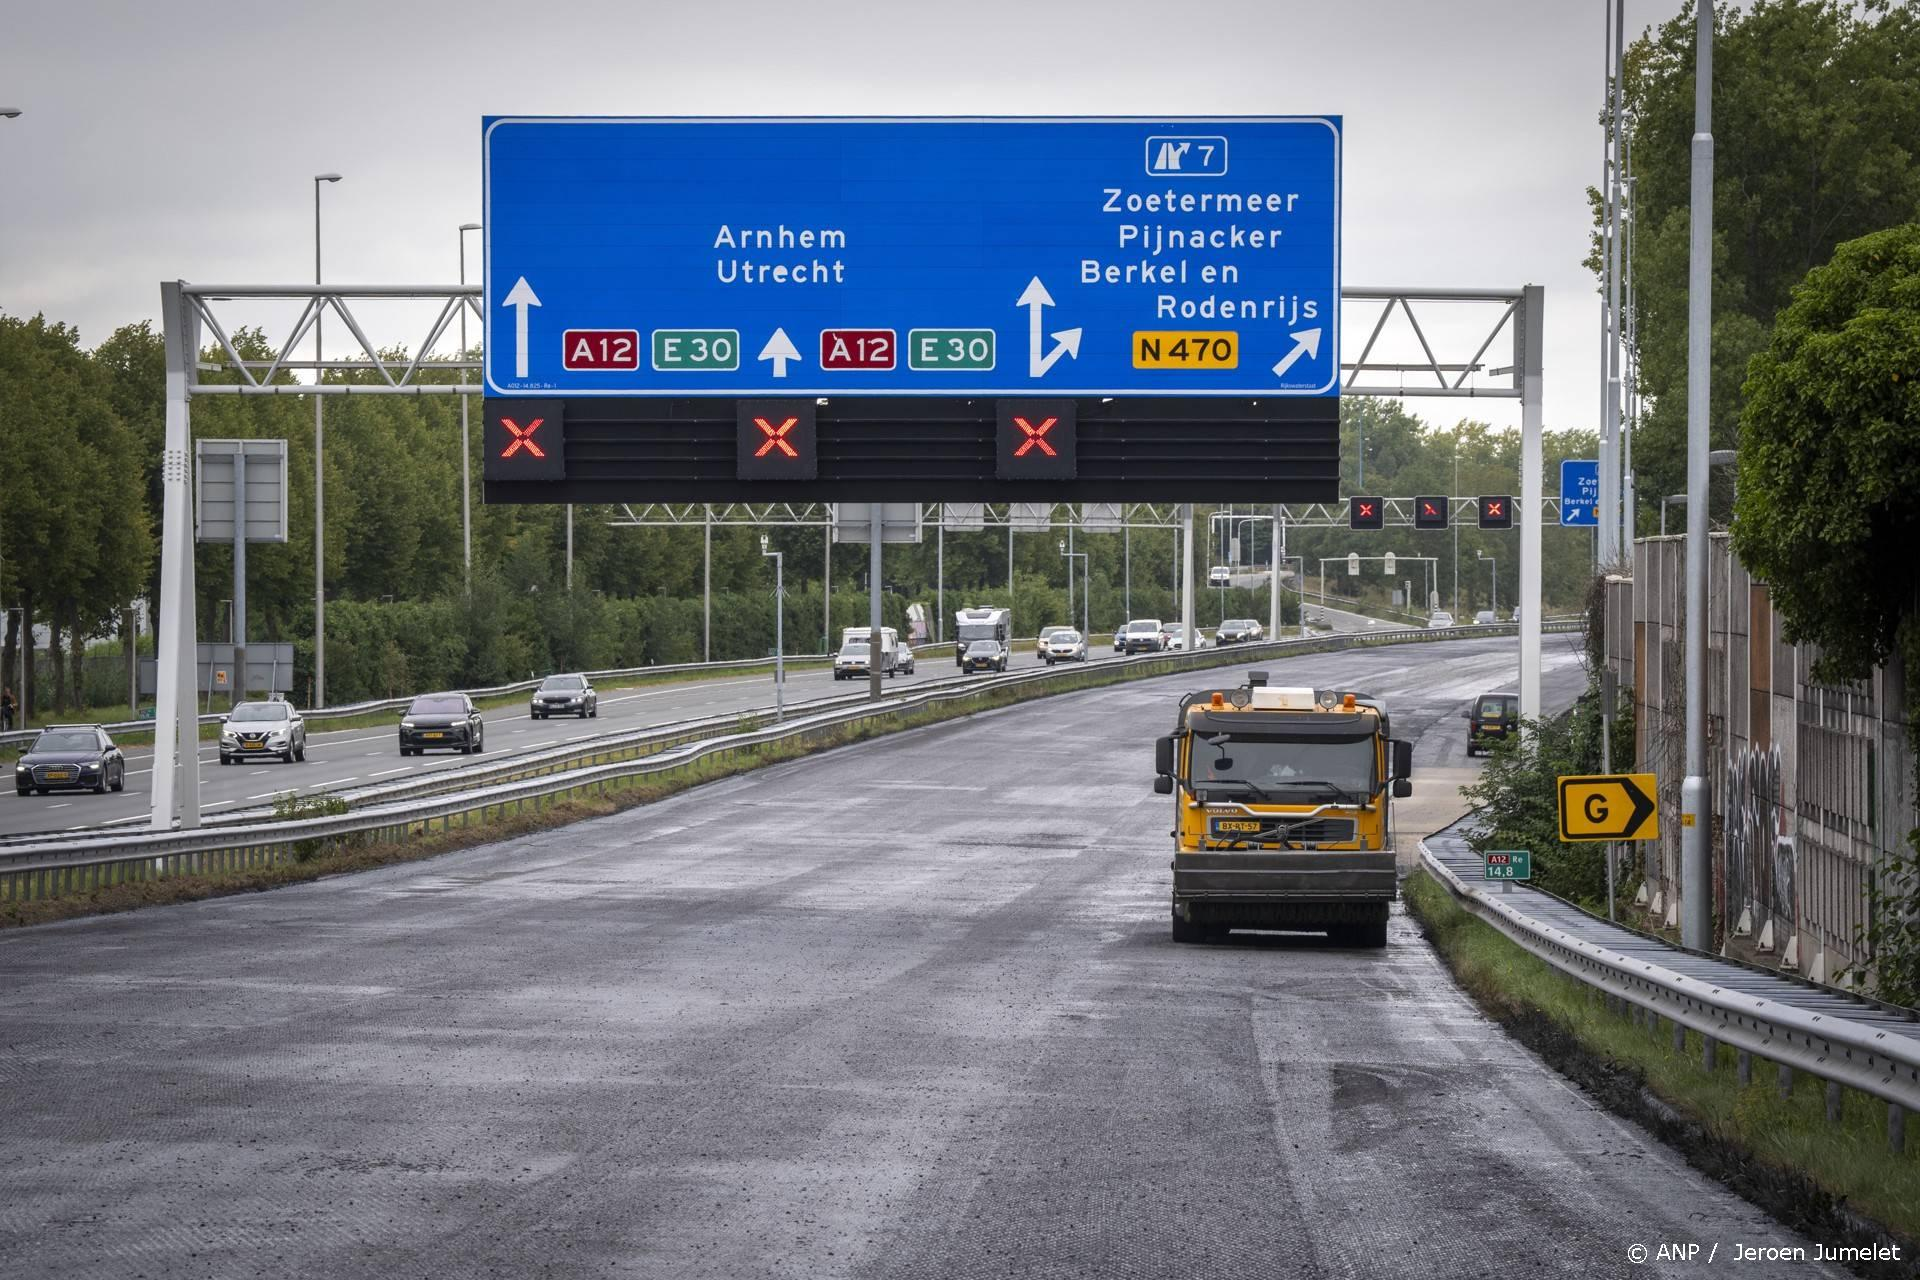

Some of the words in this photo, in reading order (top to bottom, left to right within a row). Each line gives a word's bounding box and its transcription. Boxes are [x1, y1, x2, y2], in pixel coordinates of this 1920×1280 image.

[1197, 145, 1215, 167] 7
[1102, 188, 1299, 213] Zoetermeer
[713, 224, 846, 249] Arnhem
[1119, 224, 1282, 256] Pijnacker
[717, 259, 845, 284] Utrecht
[1081, 259, 1187, 284] Berkel
[1201, 265, 1238, 284] en
[1157, 294, 1318, 327] Rodenrijs
[571, 337, 632, 362] A12
[828, 337, 889, 362] A12
[1584, 793, 1609, 824] G
[1487, 866, 1514, 878] 14,8
[1491, 856, 1507, 864] A12
[1512, 855, 1524, 864] Re
